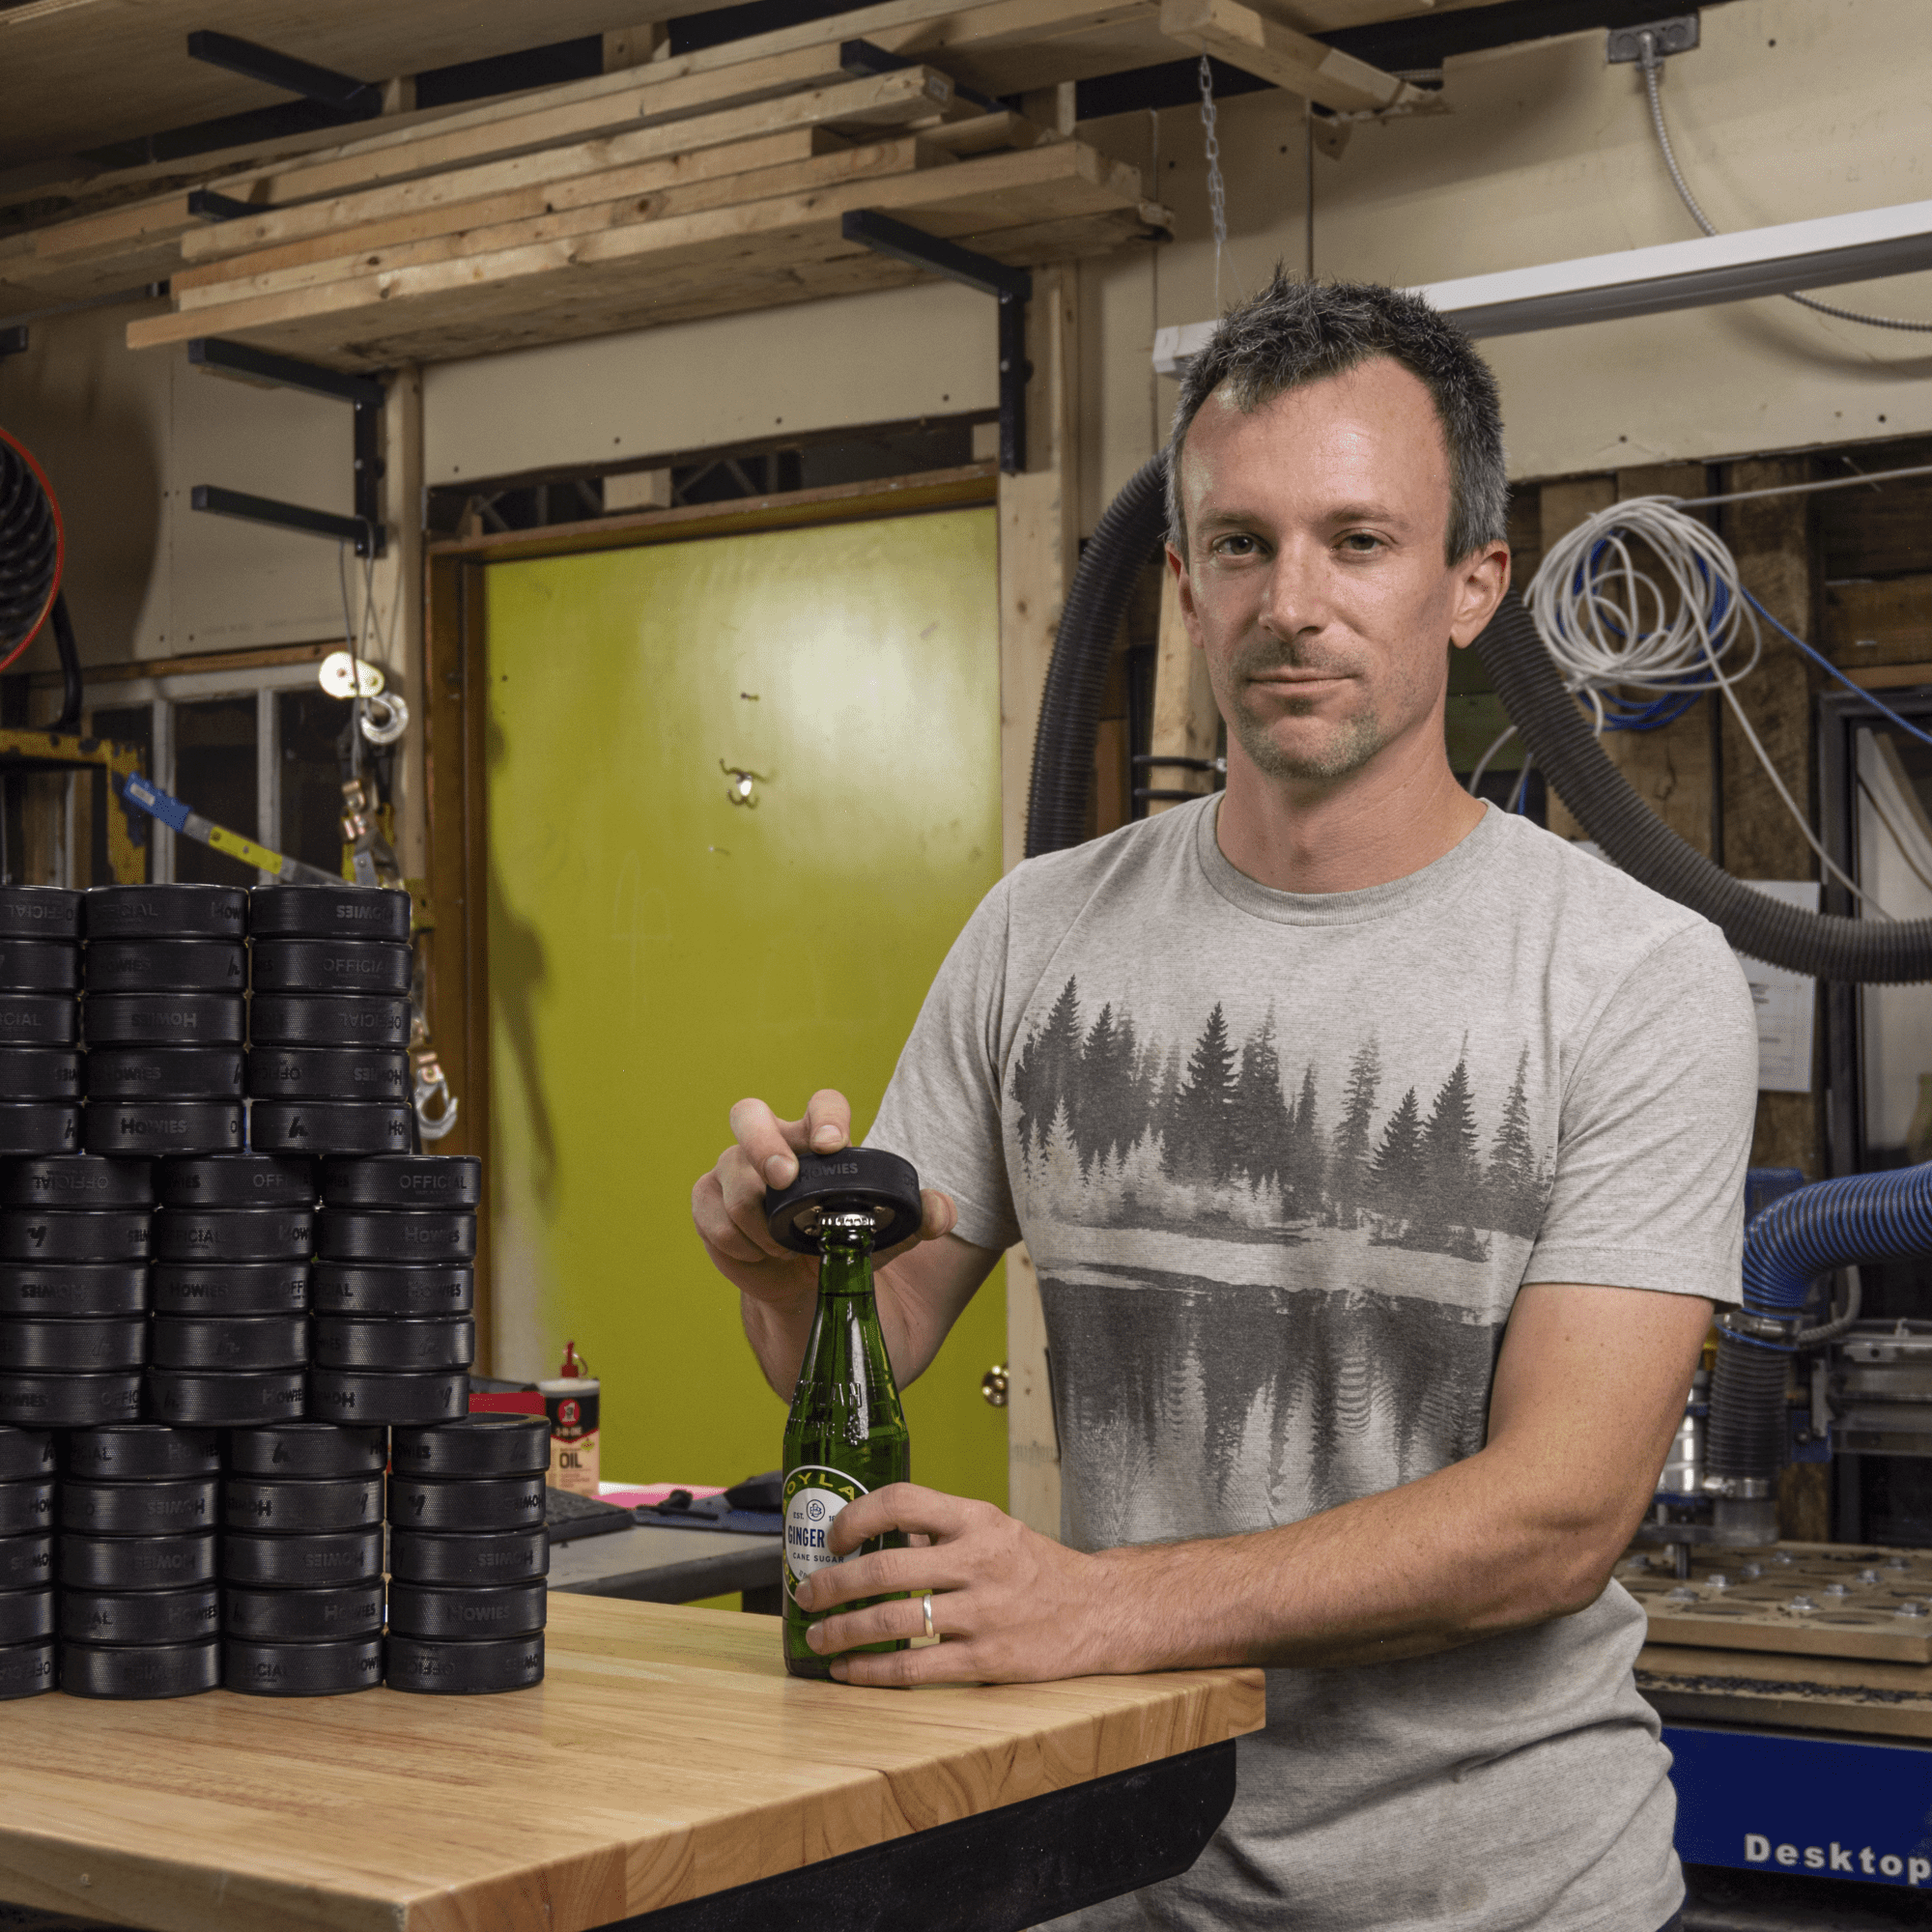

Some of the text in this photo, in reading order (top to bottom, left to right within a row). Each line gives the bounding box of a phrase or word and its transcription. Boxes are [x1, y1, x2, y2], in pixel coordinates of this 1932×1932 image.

[121, 1118, 187, 1135] HOWIES
[32, 1176, 109, 1190] OFFICIAL
[169, 1280, 228, 1299] HOWIES
[559, 1452, 582, 1469] OIL
[793, 1511, 804, 1520] EST.
[788, 1524, 825, 1548] GINGER
[304, 1551, 364, 1568] HOWIES
[476, 1550, 534, 1568] HOWIES
[793, 1551, 844, 1563] CANE SUGAR
[445, 1605, 511, 1623] HOWIES
[1745, 1833, 1932, 1885] Desktop
